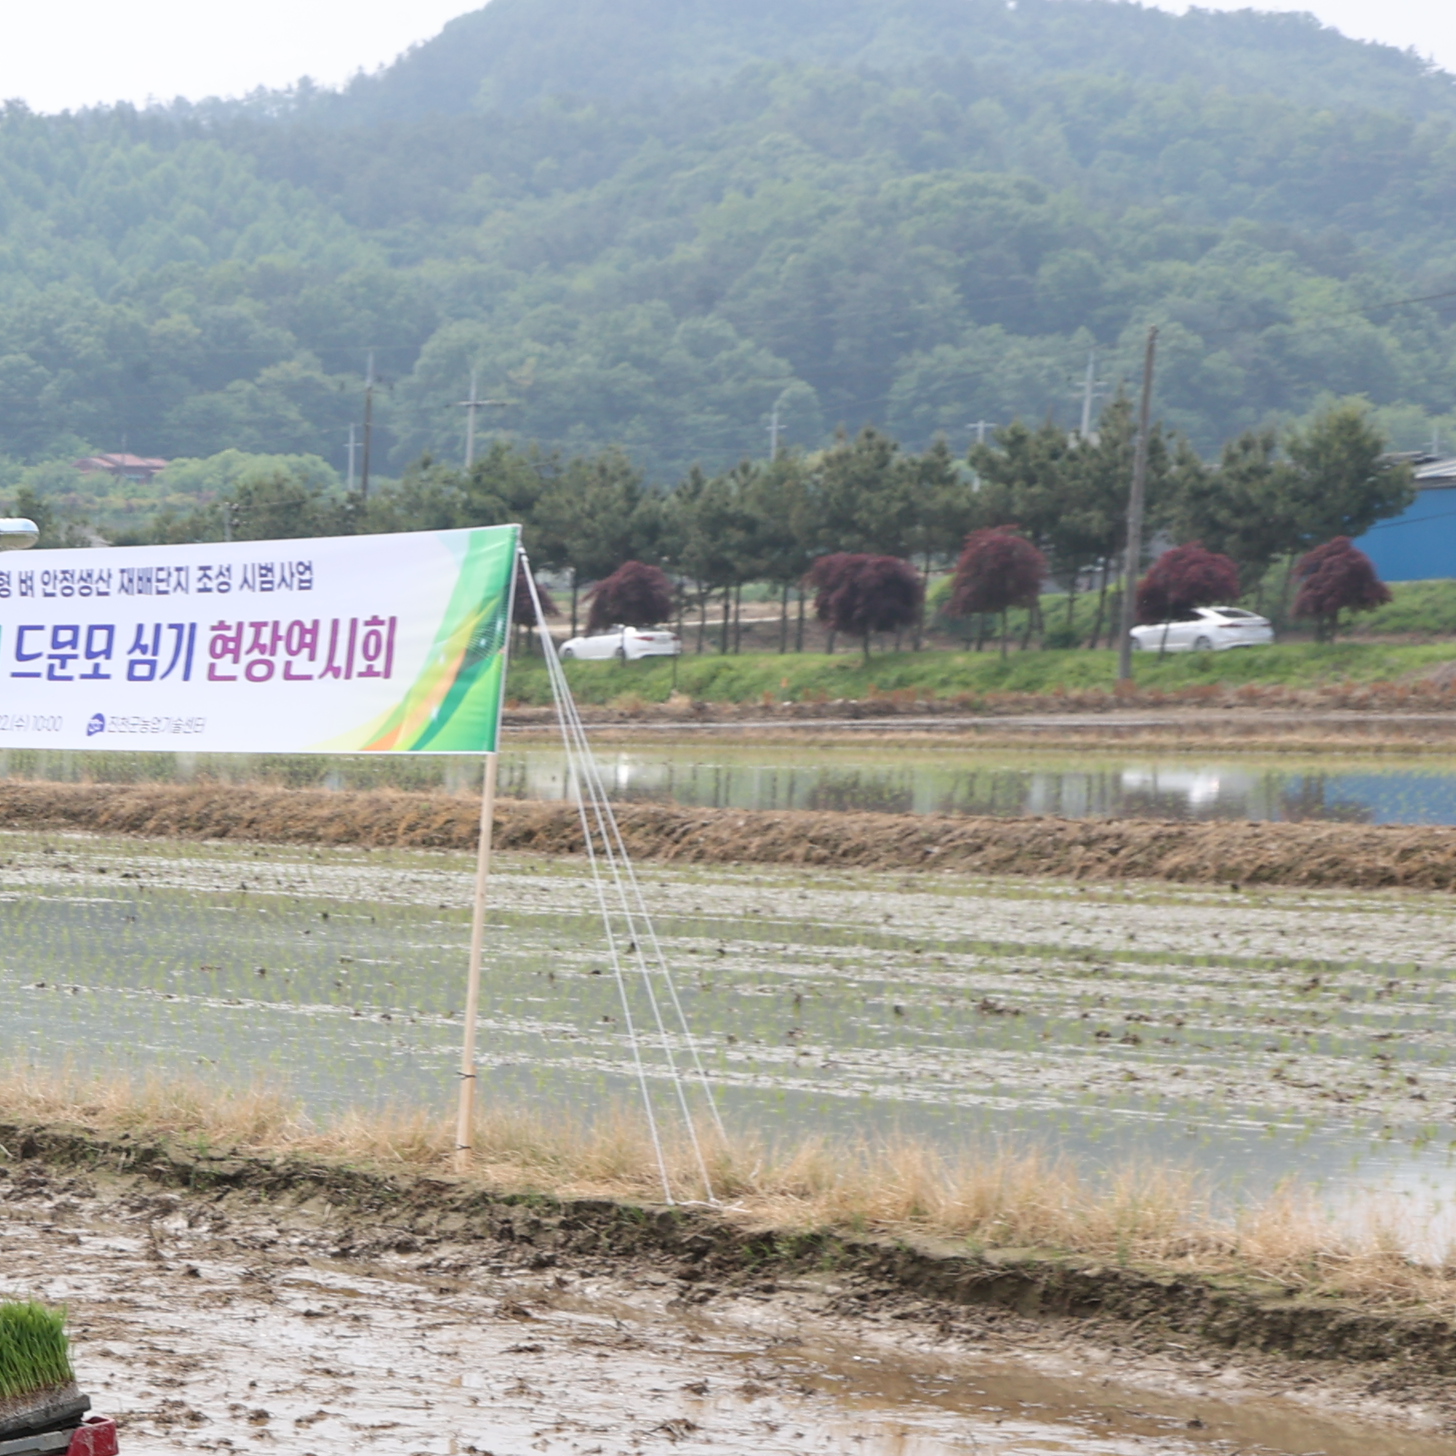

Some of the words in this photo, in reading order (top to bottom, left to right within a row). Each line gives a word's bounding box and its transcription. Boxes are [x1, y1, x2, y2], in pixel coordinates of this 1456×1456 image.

[18, 570, 35, 598] 벼
[41, 568, 112, 598] 안정생산
[118, 565, 189, 596] 재배단지
[196, 563, 232, 594] 조성
[239, 560, 313, 593] 시범사업
[10, 624, 115, 682] 드문모
[127, 622, 197, 682] 심기
[207, 614, 397, 682] 현장연시회
